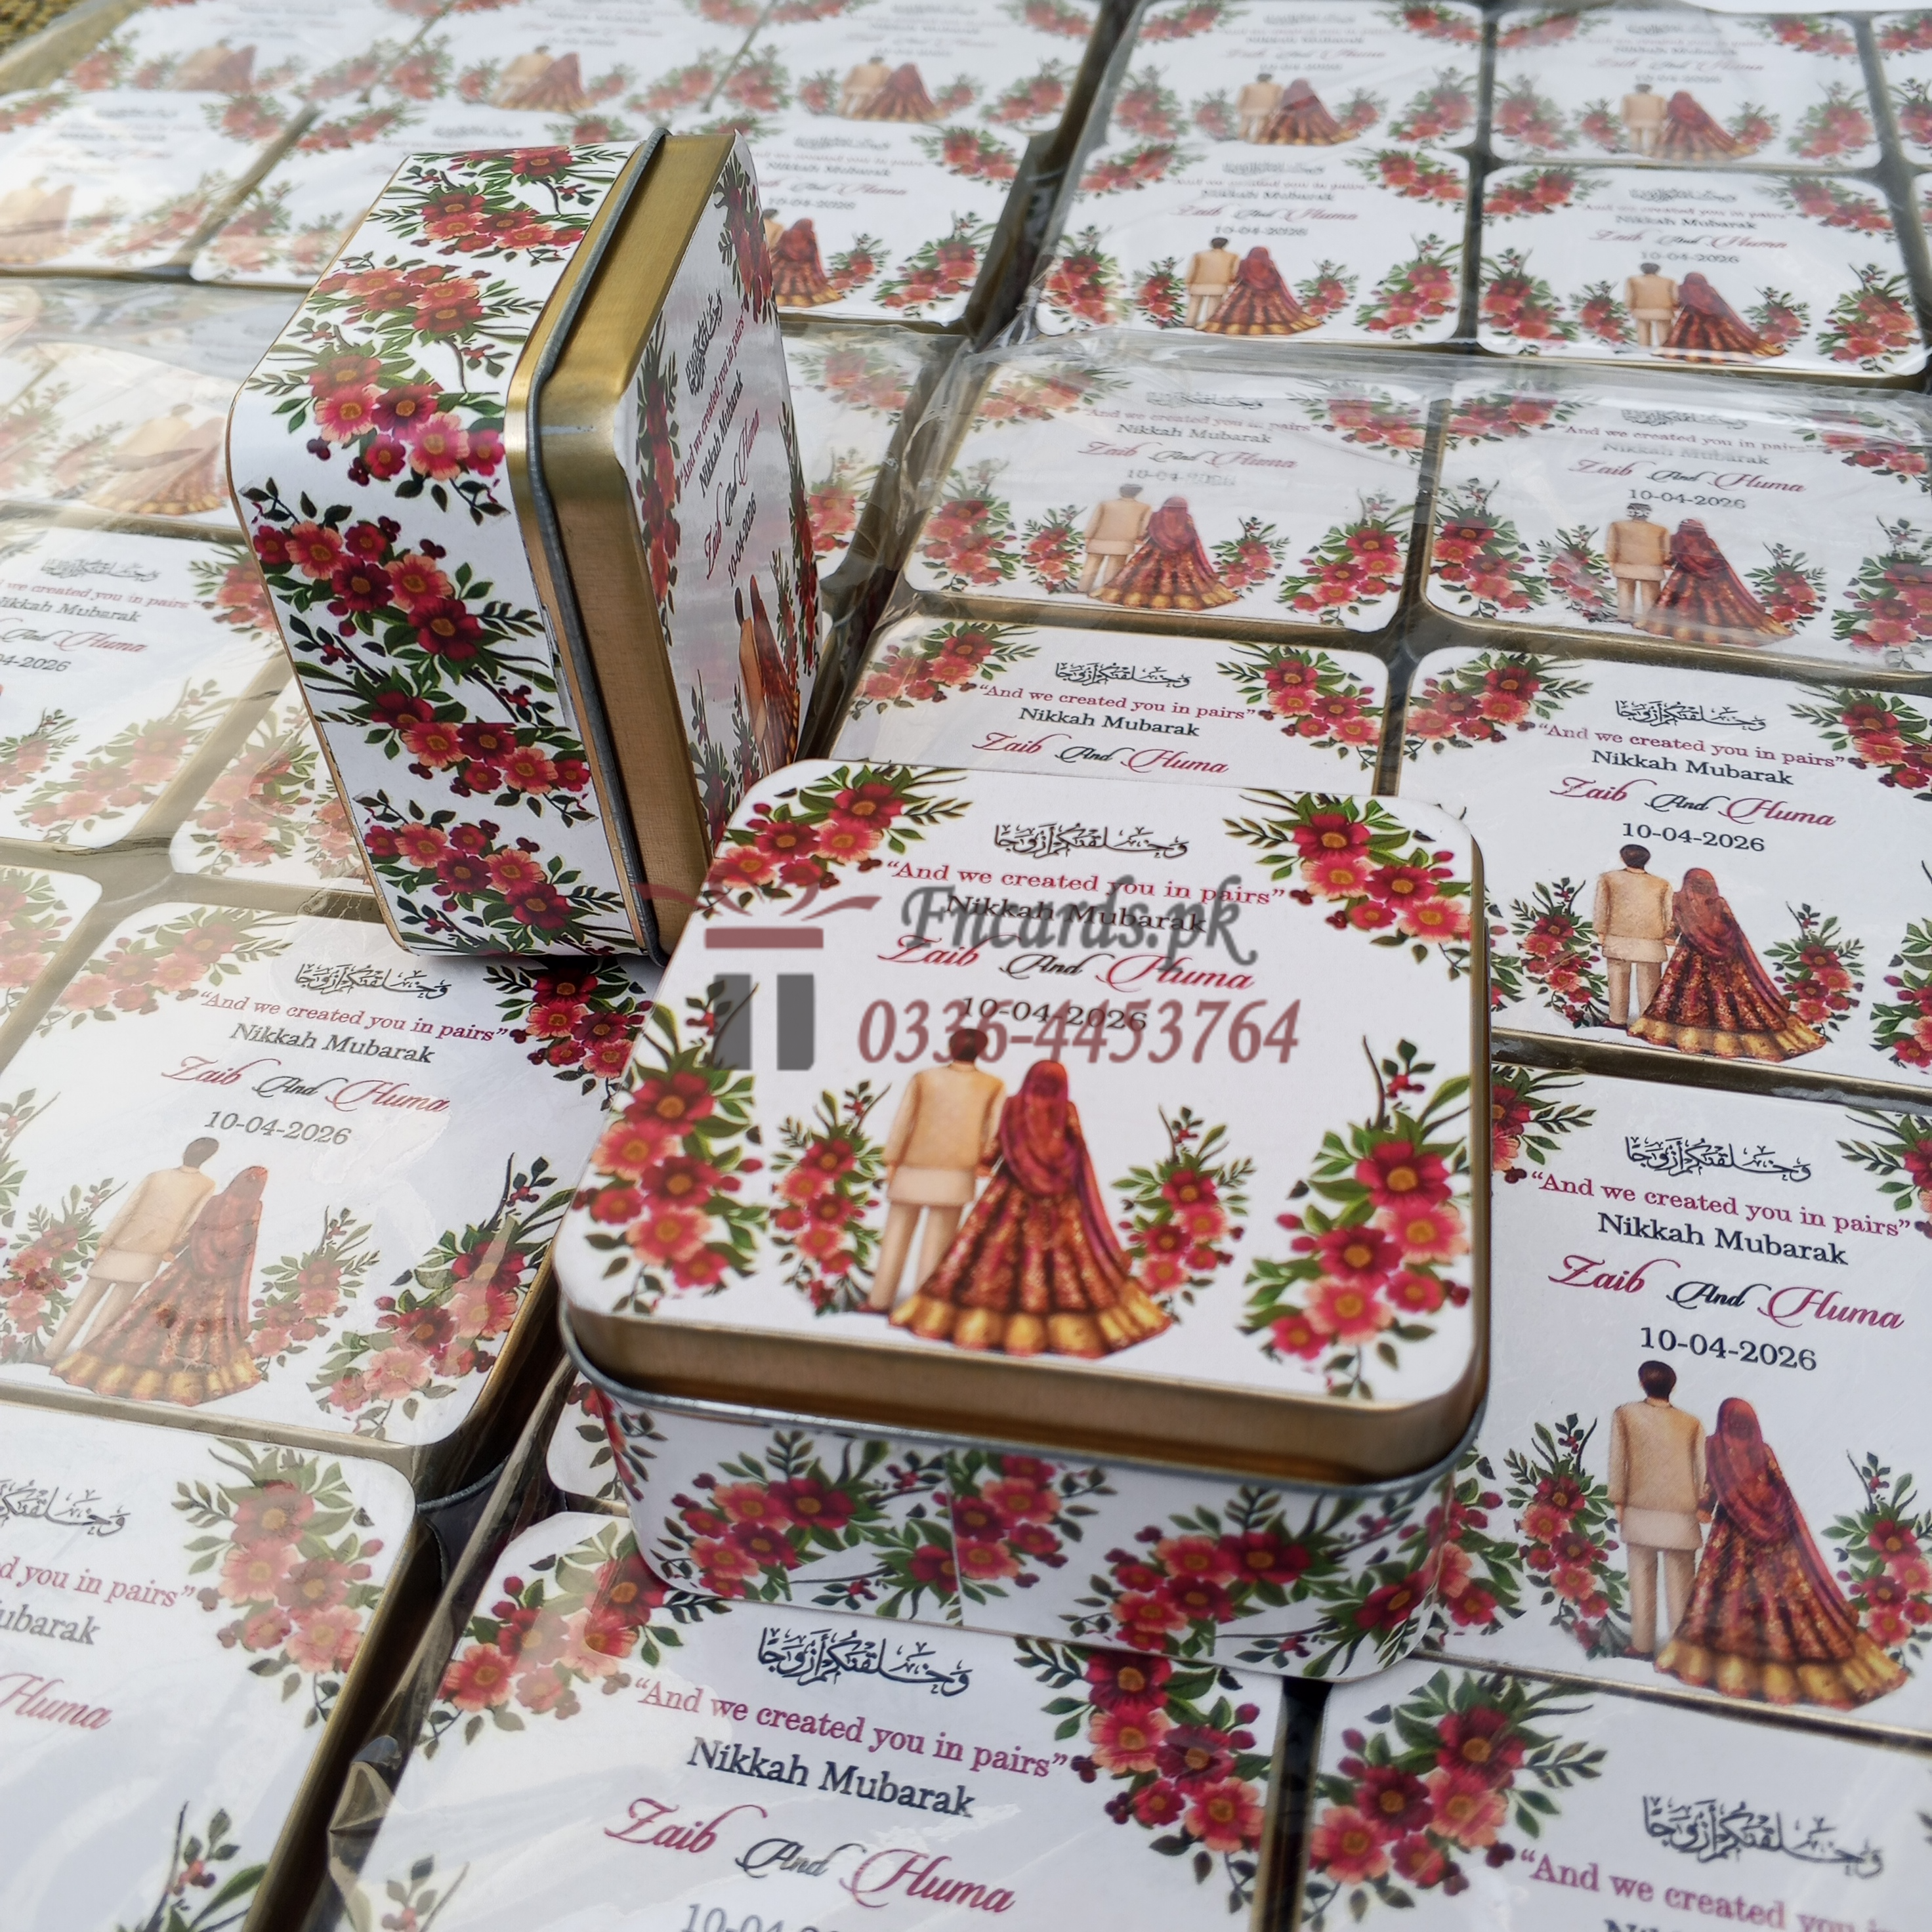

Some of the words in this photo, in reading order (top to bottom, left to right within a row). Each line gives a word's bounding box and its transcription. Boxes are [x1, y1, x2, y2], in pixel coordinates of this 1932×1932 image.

[694, 430, 702, 455] we
[702, 376, 720, 435] created
[719, 359, 728, 395] you
[726, 345, 734, 366] in
[699, 432, 721, 499] Nikkah
[719, 369, 743, 444] Mubarak
[1633, 432, 1696, 443] created
[1701, 438, 1732, 446] you
[1738, 437, 1755, 448] in
[704, 482, 723, 580] Zaib
[725, 452, 738, 526] And
[738, 408, 759, 486] Huma
[1567, 459, 1656, 476] Zaib
[1646, 471, 1717, 482] And
[1706, 473, 1807, 492] Huma
[1628, 489, 1746, 509] 10-04-2026
[728, 492, 756, 587] 10-04-2026
[0, 597, 52, 612] ikkah
[56, 603, 141, 622] Mubarak
[31, 584, 93, 598] created
[130, 593, 142, 604] in
[54, 631, 148, 652] Huma
[0, 653, 72, 672] 4-2026
[1018, 707, 1095, 726] Nikkah
[1101, 715, 1200, 737] Mubarak
[1029, 692, 1053, 702] we
[1059, 694, 1126, 708] created
[1131, 701, 1165, 712] you
[1171, 703, 1190, 714] in
[972, 732, 1072, 753] Zaib
[1055, 746, 1135, 763] And
[1121, 748, 1229, 773] Huma
[1595, 732, 1623, 743] we
[1630, 736, 1704, 751] created
[1711, 744, 1749, 757] you
[1755, 747, 1776, 761] in
[1592, 750, 1677, 772] Nikkah
[1685, 760, 1794, 785] Mubarak
[1550, 777, 1657, 801] Zaib
[1644, 794, 1731, 812] And
[1718, 798, 1836, 826] Huma
[1622, 822, 1765, 852] 10-04-2026
[957, 871, 992, 884] we
[1001, 874, 1099, 892] created
[1106, 881, 1155, 898] you
[1164, 881, 1191, 899] in
[946, 895, 1054, 921] Nikkah
[1066, 904, 1206, 933] Mubarak
[877, 934, 1022, 966] Zaib
[999, 953, 1116, 980] And
[1095, 955, 1255, 993] Huma
[254, 1002, 281, 1015] we
[287, 1006, 364, 1024] created
[364, 1017, 406, 1030] you
[411, 1018, 433, 1035] in
[230, 1023, 318, 1049] Nikkah
[322, 1034, 435, 1063] Mubarak
[161, 1056, 281, 1085] Zaib
[252, 1076, 348, 1097] And
[326, 1080, 450, 1113] Huma
[205, 1110, 351, 1144] 10-04-2026
[1601, 1186, 1636, 1201] we
[1644, 1191, 1738, 1215] created
[1746, 1205, 1792, 1222] you
[1799, 1208, 1825, 1227] in
[1597, 1212, 1705, 1246] Nikkah
[1714, 1228, 1849, 1265] Mubarak
[1548, 1255, 1681, 1293] Zaib
[1666, 1282, 1771, 1309] And
[1757, 1287, 1904, 1330] Huma
[1641, 1327, 1816, 1370] 10-04-2026
[16, 1566, 70, 1588] you
[74, 1568, 102, 1595] in
[0, 1601, 100, 1646] ubarak
[710, 1696, 747, 1720] we
[756, 1708, 863, 1742] created
[868, 1727, 925, 1754] you
[933, 1733, 964, 1761] in
[686, 1736, 809, 1786] Nikkah
[818, 1761, 975, 1818] Mubarak
[604, 1797, 767, 1853] Zaib
[736, 1838, 866, 1878] And
[839, 1848, 1017, 1913] Huma
[1609, 1875, 1654, 1902] we
[1664, 1887, 1786, 1929] created
